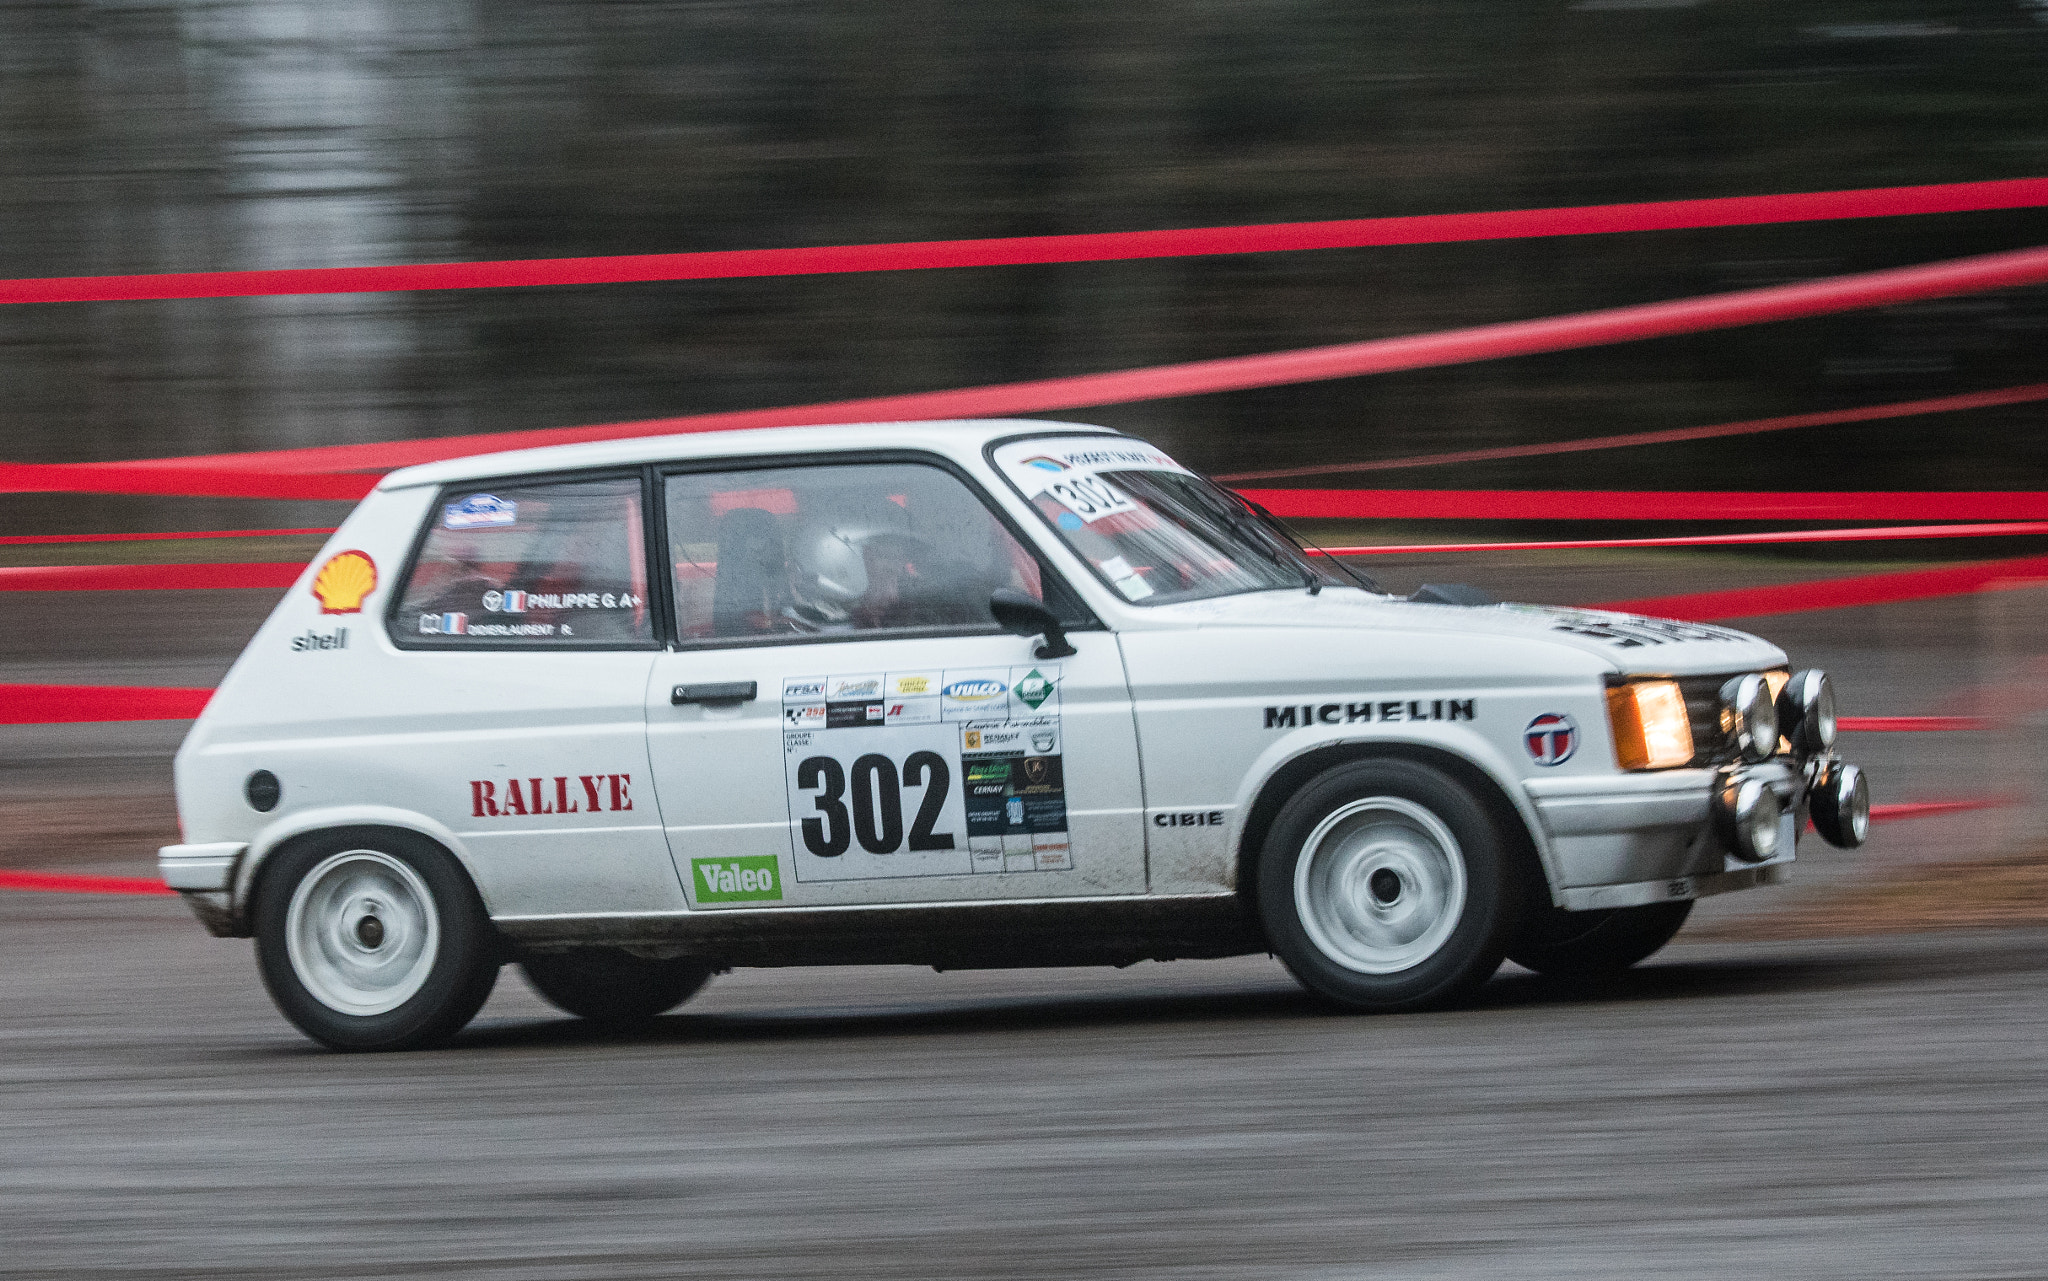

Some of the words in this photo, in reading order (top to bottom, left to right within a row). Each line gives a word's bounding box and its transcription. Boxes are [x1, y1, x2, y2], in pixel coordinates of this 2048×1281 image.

[1053, 476, 1126, 514] 302
[527, 592, 598, 609] PHILIPPE
[291, 628, 349, 653] shell
[949, 682, 1001, 698] VULCO
[1263, 698, 1478, 730] MICHELIN
[470, 774, 633, 818] RALLYE
[797, 750, 956, 858] 302
[1153, 810, 1226, 828] CIBIE
[698, 862, 773, 894] Valeo
